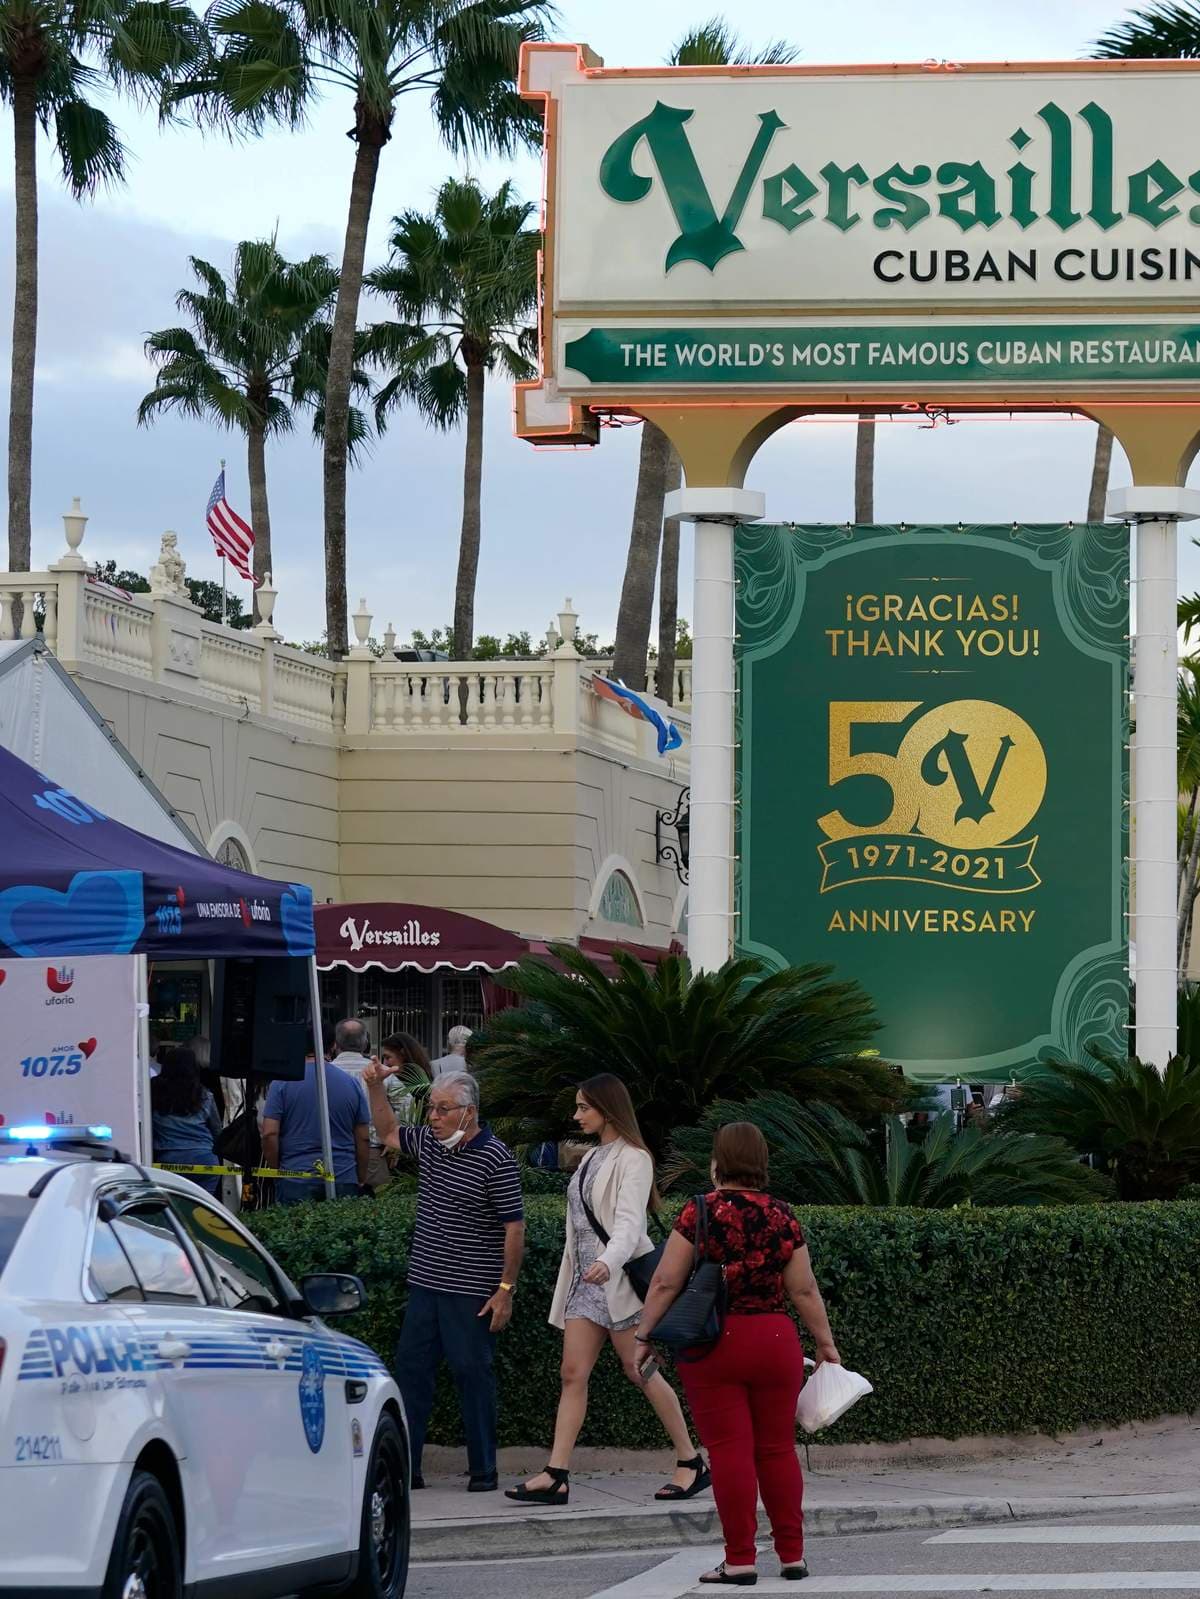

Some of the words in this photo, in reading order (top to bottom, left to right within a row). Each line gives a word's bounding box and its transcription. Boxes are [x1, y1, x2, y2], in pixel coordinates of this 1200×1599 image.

[873, 248, 1037, 282] CUBAN
[620, 343, 667, 367] THE
[675, 343, 785, 367] WORLD'S
[792, 342, 861, 366] MOST
[868, 342, 969, 366] FAMOUS
[976, 341, 1062, 365] CUBAN
[846, 594, 1018, 622] ¡GRACIAS!
[825, 629, 945, 656] THANK
[956, 629, 1040, 656] YOU!
[847, 844, 1005, 880] 1971-2021
[339, 916, 441, 951] Versailles
[828, 909, 1036, 933] ANNIVERSARY
[45, 995, 75, 1006] uforia
[20, 1054, 83, 1078] 107.5
[45, 1325, 146, 1377] POLICE
